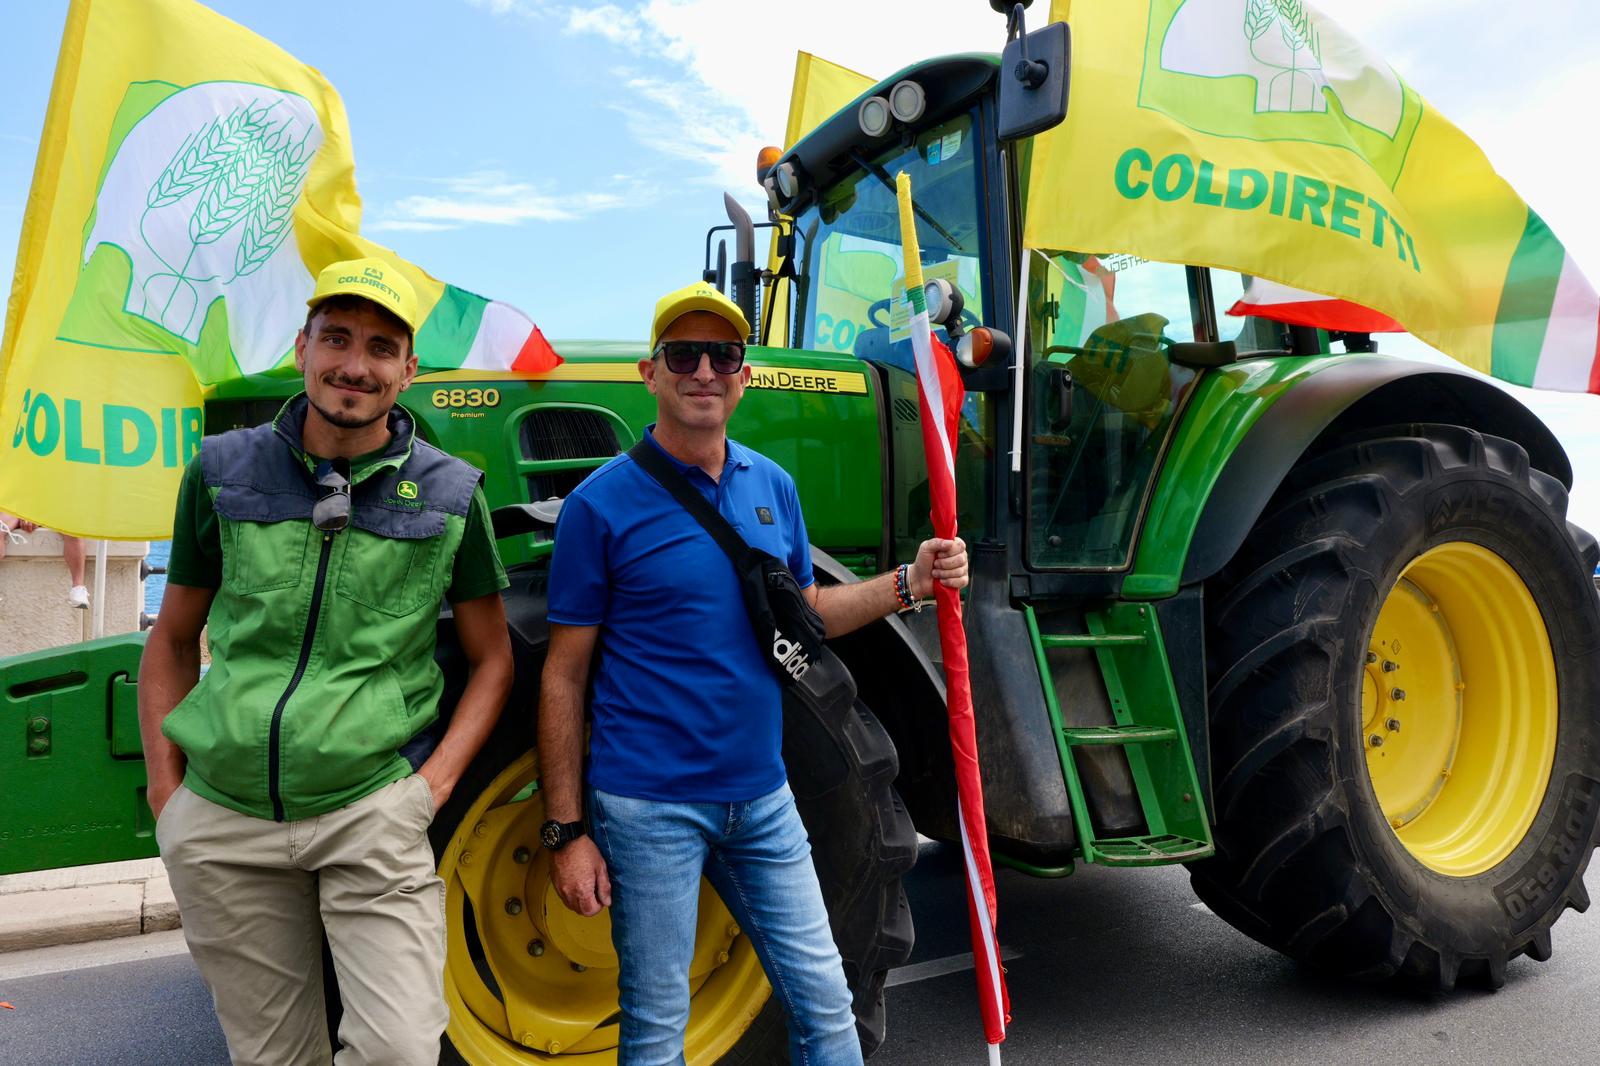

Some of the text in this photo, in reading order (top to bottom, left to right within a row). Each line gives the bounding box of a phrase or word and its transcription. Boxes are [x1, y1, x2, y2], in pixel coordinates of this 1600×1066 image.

[1114, 147, 1421, 273] COLDIRETTI
[338, 276, 401, 303] COLDIRETTI
[750, 372, 838, 390] HN DEERE
[432, 388, 500, 408] 6830
[1504, 862, 1560, 920] 650
